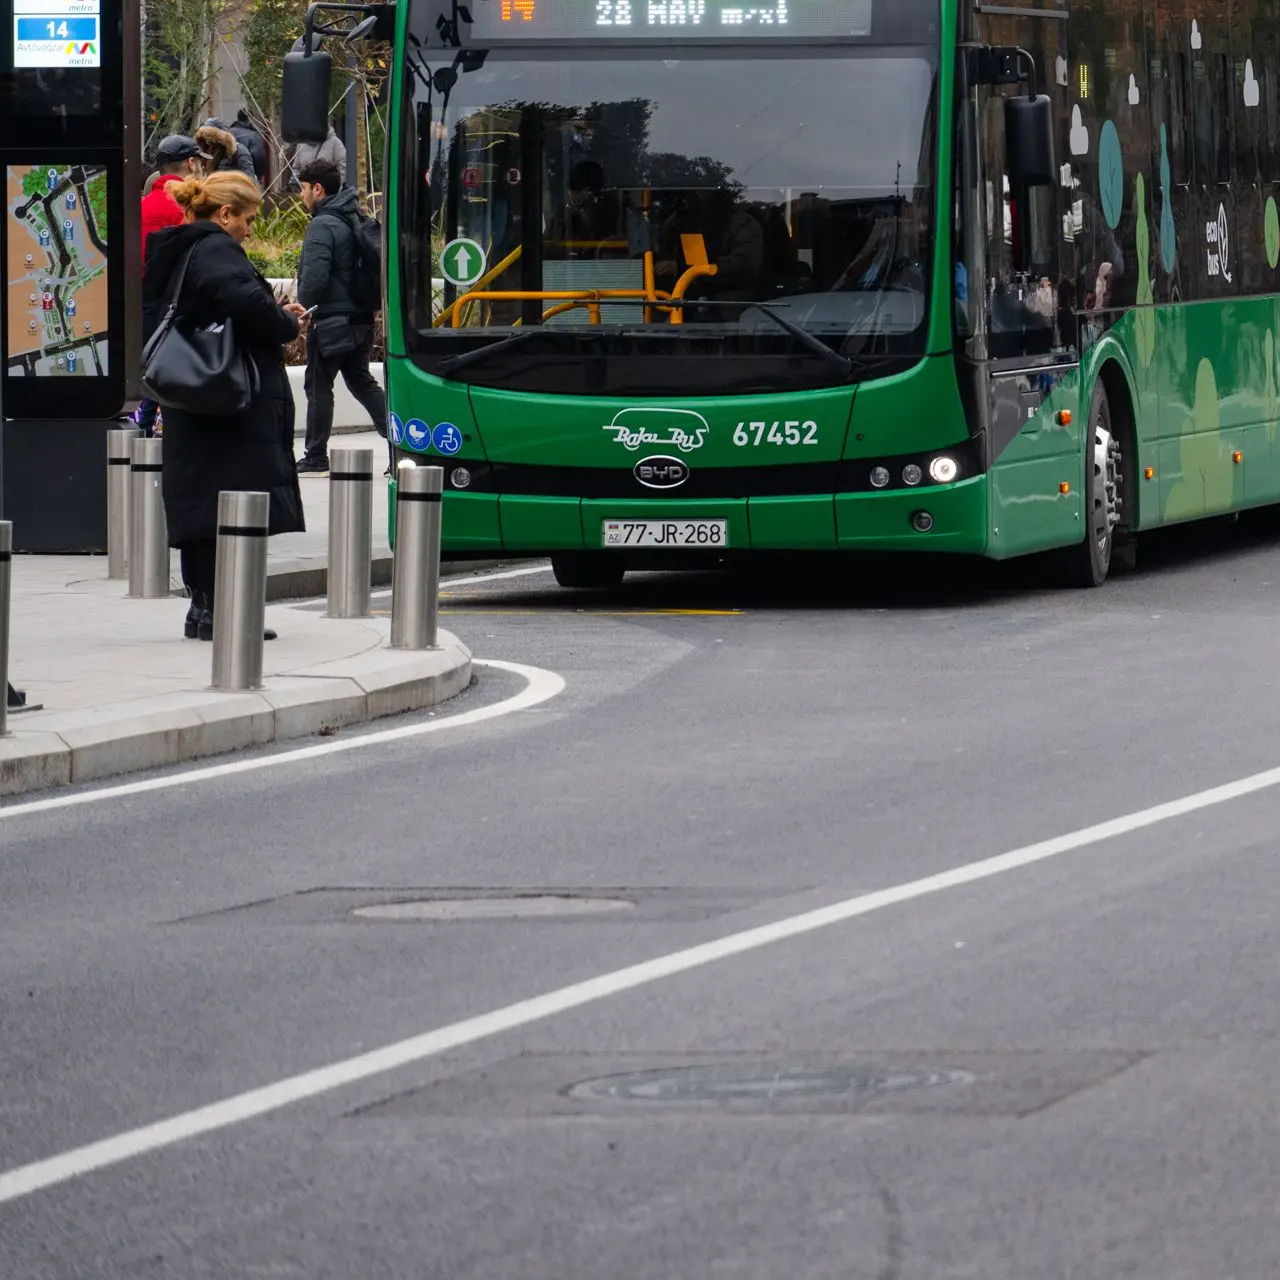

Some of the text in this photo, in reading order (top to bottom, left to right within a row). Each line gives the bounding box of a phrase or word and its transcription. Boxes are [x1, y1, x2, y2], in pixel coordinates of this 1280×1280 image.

[68, 3, 93, 12] metro
[596, 0, 632, 25] 28
[647, 0, 706, 25] MAY
[46, 20, 69, 38] 14
[68, 57, 93, 65] metro
[1206, 221, 1218, 243] eco
[1207, 248, 1220, 276] bus
[603, 426, 708, 453] Baku Bus
[732, 420, 819, 447] 67452
[639, 466, 683, 480] BYD
[608, 534, 620, 543] AZ
